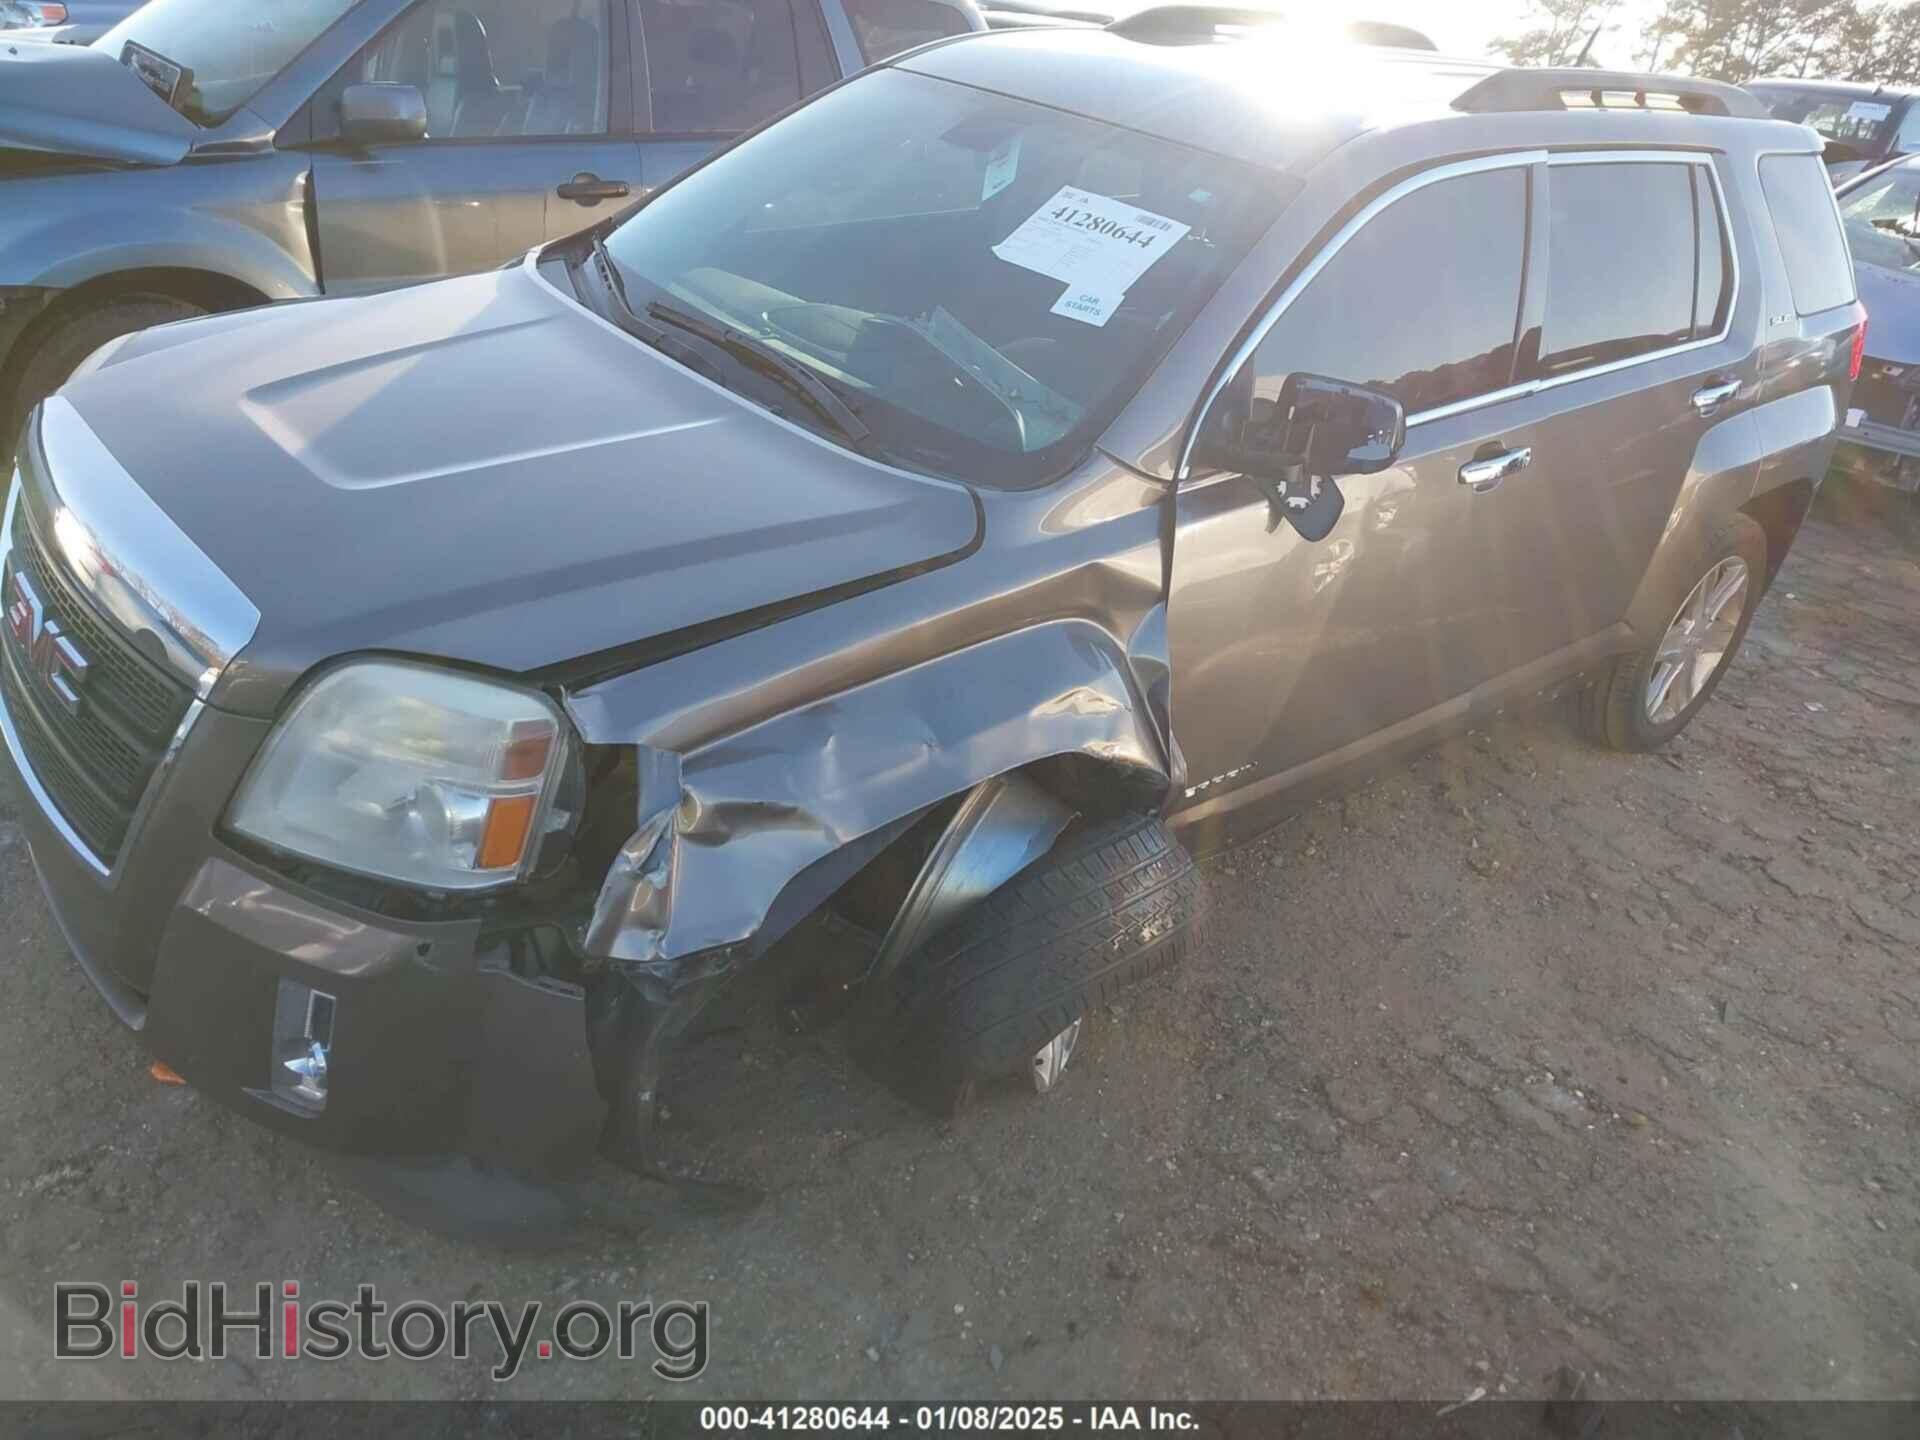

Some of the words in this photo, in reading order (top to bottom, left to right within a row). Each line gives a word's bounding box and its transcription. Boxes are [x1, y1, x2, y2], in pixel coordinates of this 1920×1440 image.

[1051, 206, 1156, 248] 41280644
[1079, 294, 1100, 305] CAR
[1064, 300, 1101, 316] STARTS
